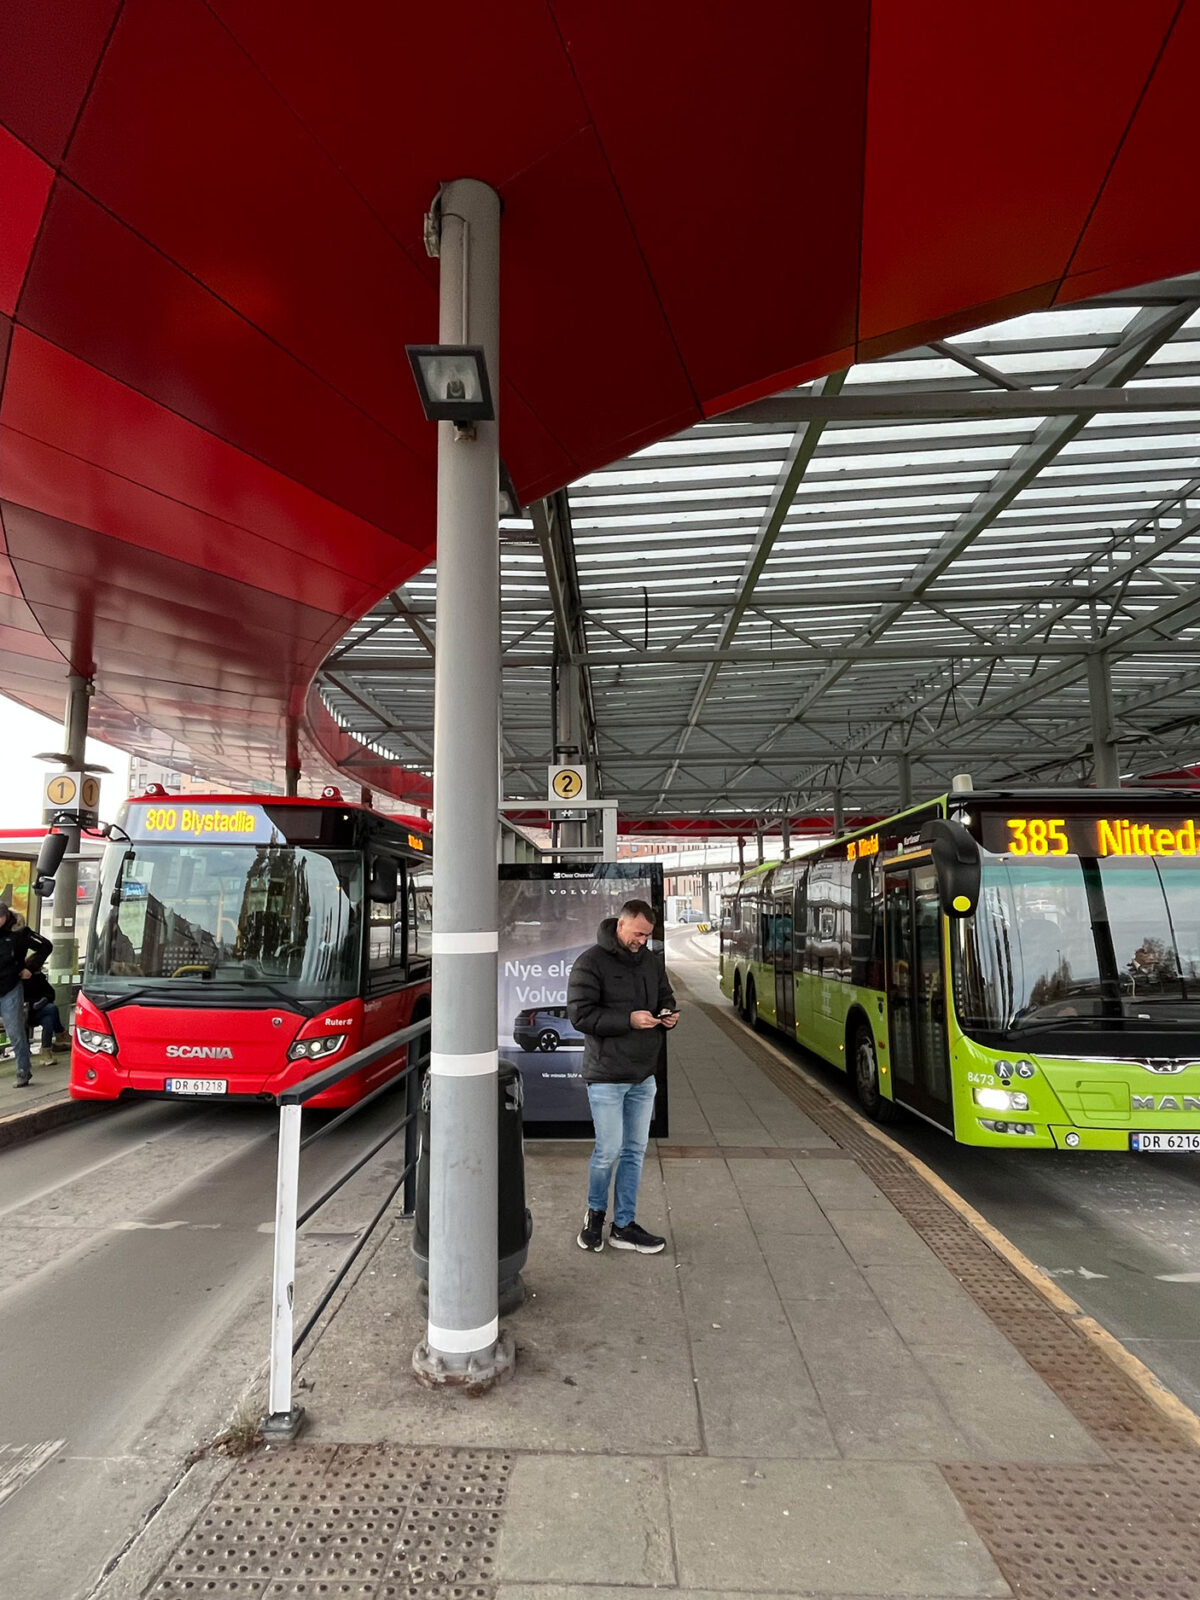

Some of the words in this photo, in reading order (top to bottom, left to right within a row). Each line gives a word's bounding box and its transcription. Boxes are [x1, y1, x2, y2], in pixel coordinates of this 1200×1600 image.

[57, 781, 65, 799] 1
[88, 784, 94, 801] 1
[562, 775, 573, 793] 2
[145, 808, 177, 831] 300
[181, 809, 256, 836] Blystadlia
[1007, 819, 1069, 856] 385
[1097, 819, 1200, 856] Nitted
[504, 960, 543, 981] Nye
[165, 1044, 234, 1060] SCANIA
[175, 1080, 189, 1091] DR
[193, 1081, 223, 1092] 61218
[967, 1071, 995, 1086] 8473
[1131, 1094, 1200, 1111] MAN
[1143, 1135, 1161, 1148] DR
